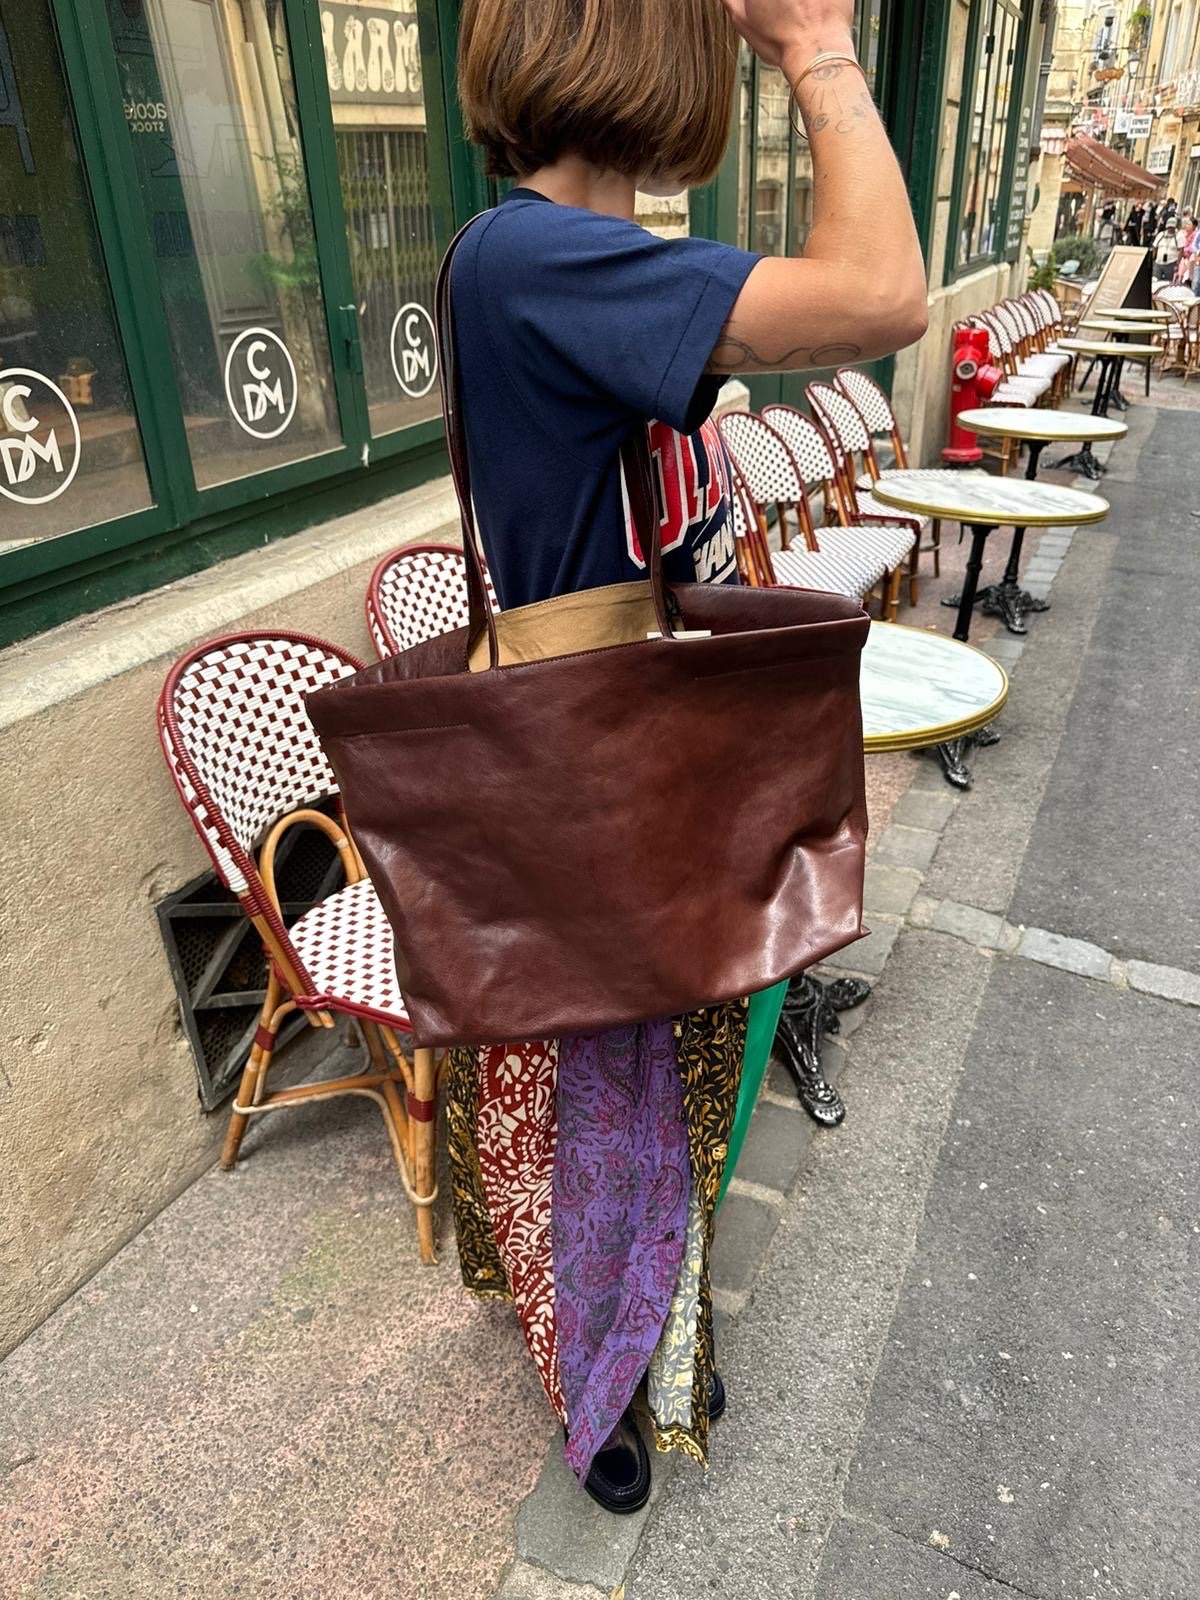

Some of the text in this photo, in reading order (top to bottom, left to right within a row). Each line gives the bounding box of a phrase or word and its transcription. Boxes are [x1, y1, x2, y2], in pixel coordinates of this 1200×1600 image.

[405, 313, 421, 347] C
[247, 340, 271, 380] C
[3, 384, 40, 432] C
